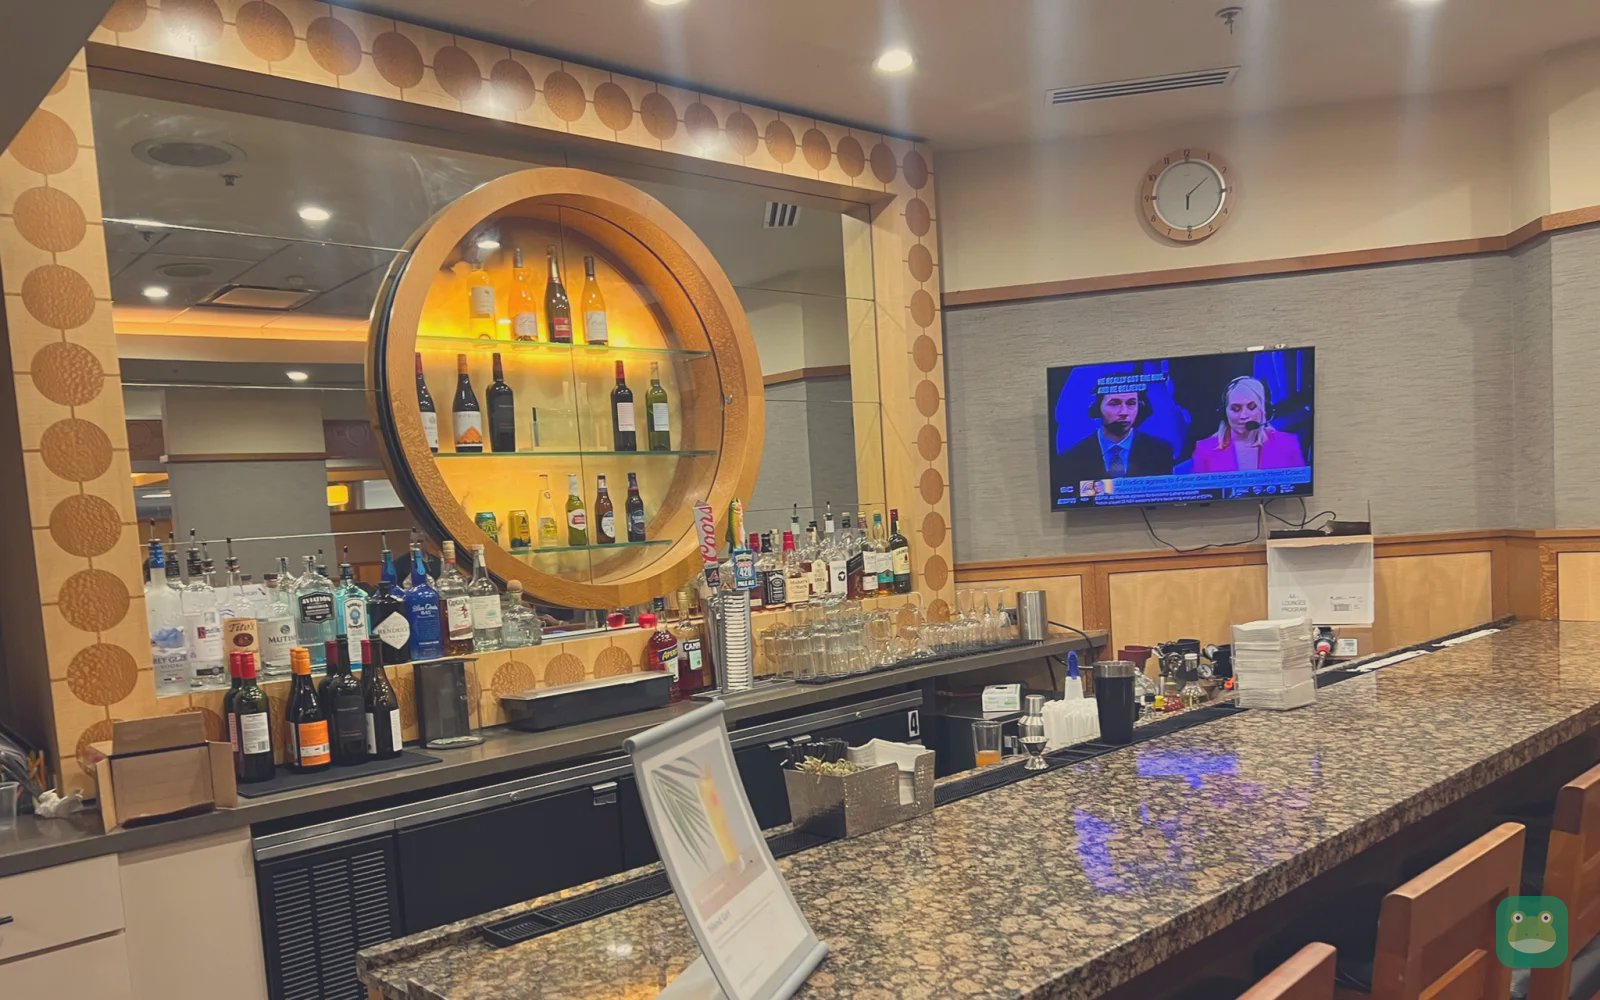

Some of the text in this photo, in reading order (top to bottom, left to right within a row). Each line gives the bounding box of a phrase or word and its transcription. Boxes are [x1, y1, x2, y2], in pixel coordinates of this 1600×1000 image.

[700, 506, 718, 562] Coors
[302, 595, 331, 604] AVIATION
[228, 622, 255, 632] Tito's
[910, 711, 918, 734] 4
